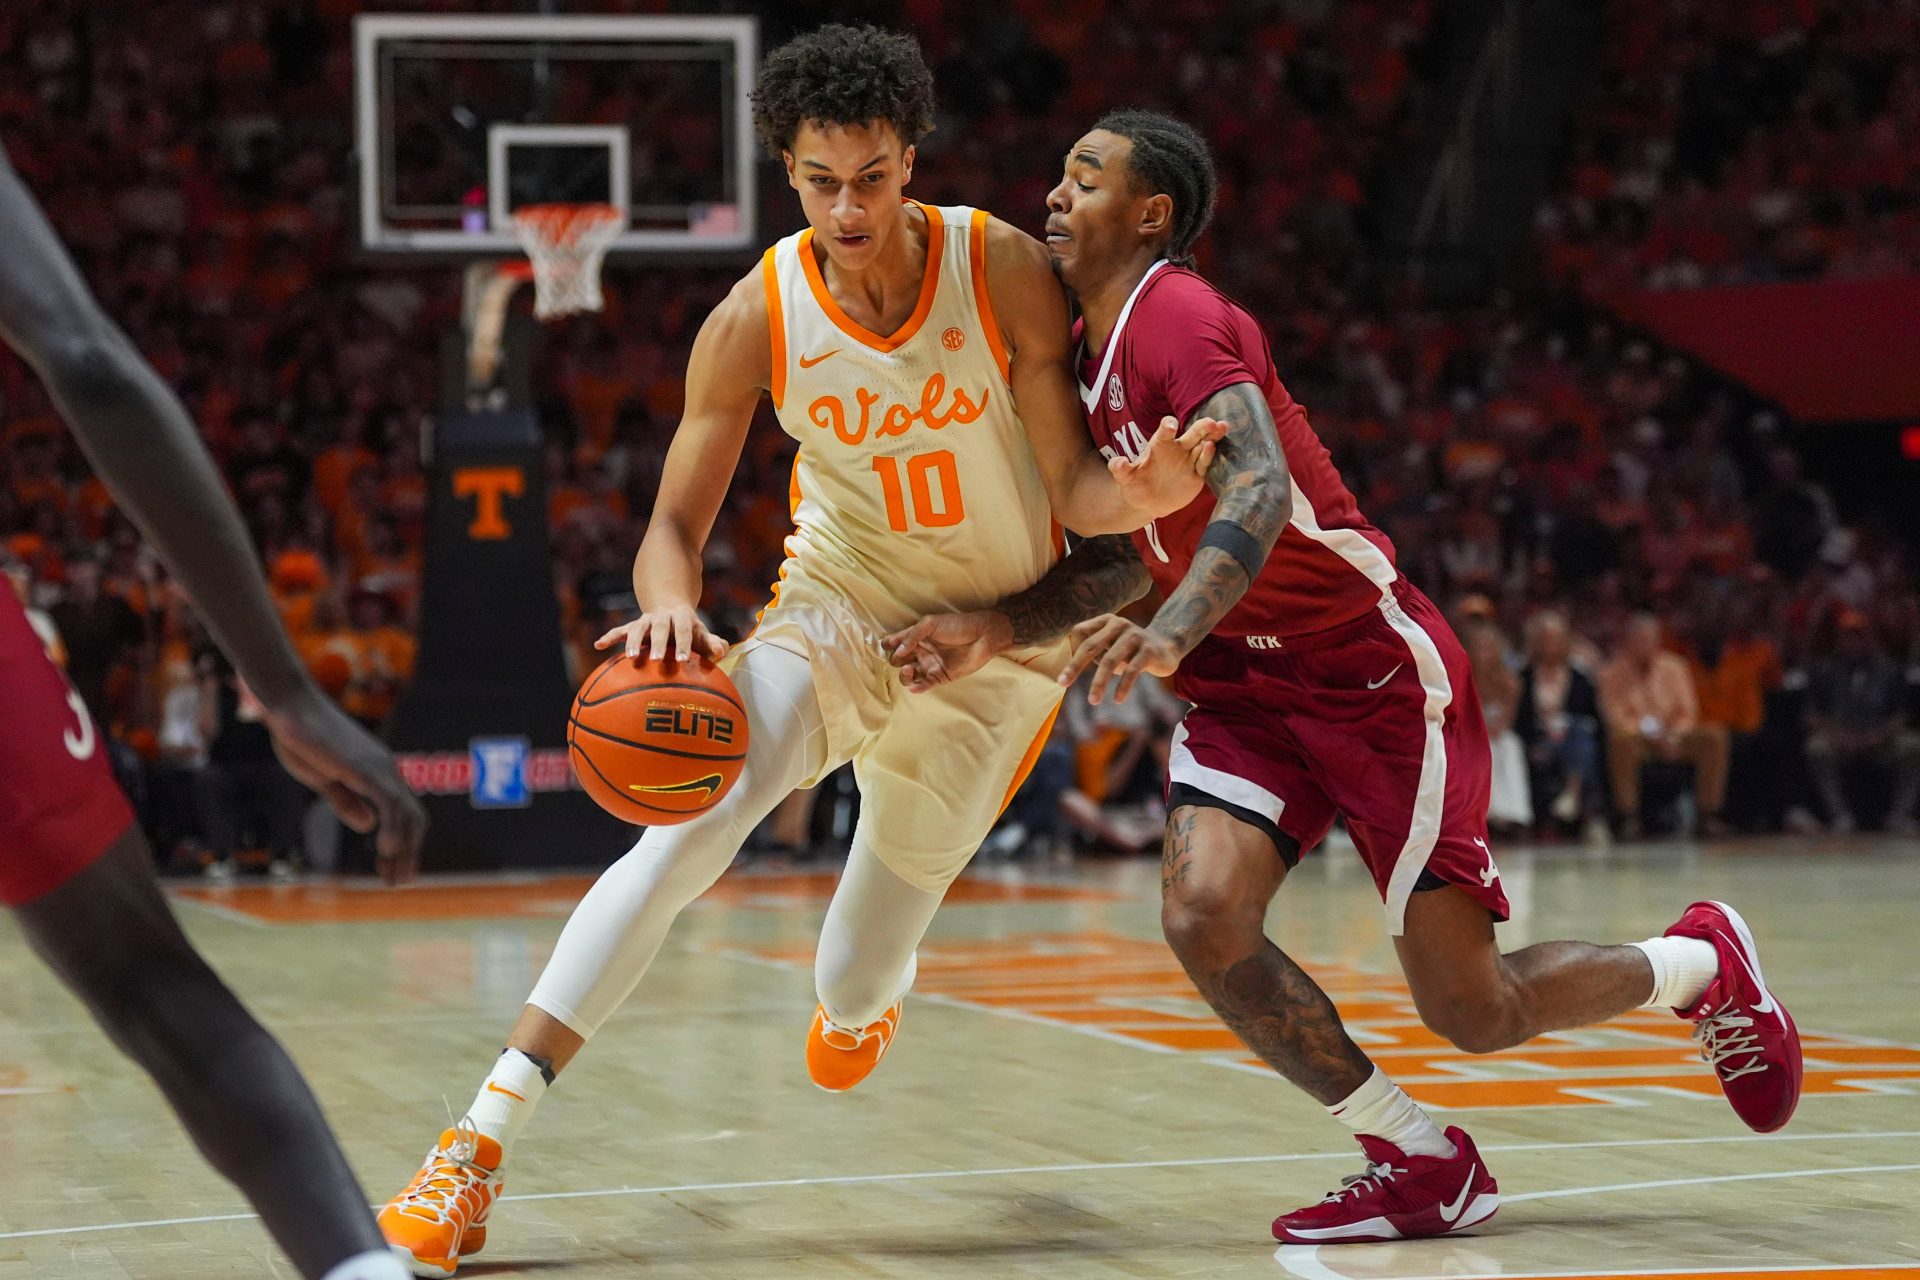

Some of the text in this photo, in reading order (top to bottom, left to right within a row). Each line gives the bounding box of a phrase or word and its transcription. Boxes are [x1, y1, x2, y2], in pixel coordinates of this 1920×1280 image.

[808, 372, 989, 445] Vols
[453, 467, 523, 539] T
[872, 449, 965, 532] 10
